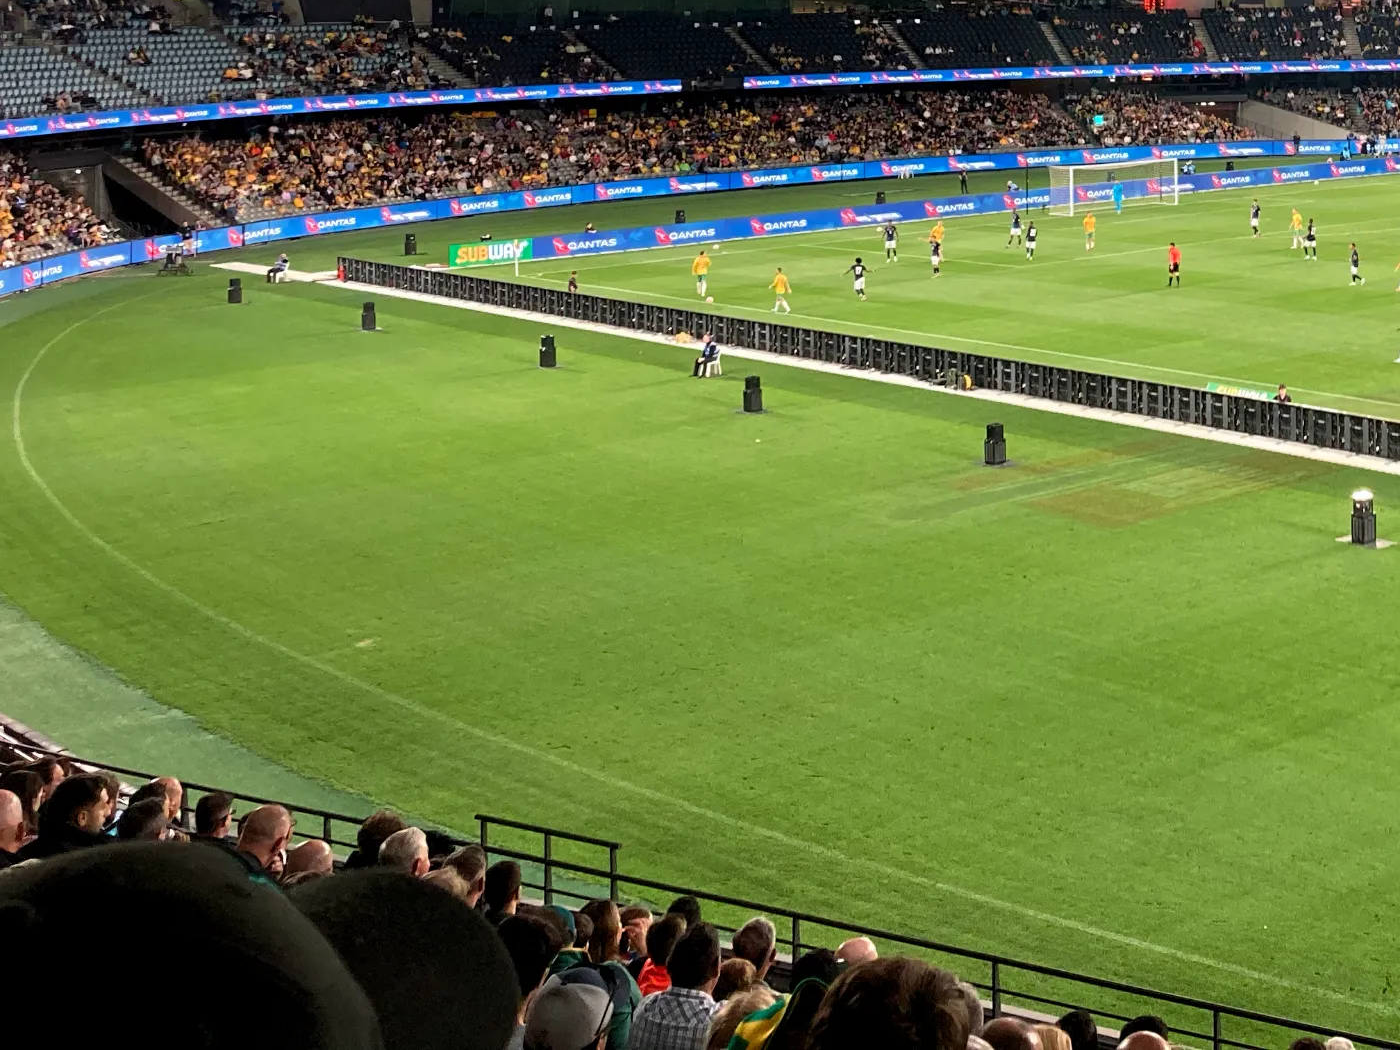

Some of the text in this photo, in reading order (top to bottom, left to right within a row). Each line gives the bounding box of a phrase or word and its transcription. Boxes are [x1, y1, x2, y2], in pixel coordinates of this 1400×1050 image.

[266, 104, 293, 112] QANTAS
[183, 110, 208, 118] QANTAS
[95, 117, 120, 125] QANTAS
[14, 125, 38, 133] QANTAS
[1161, 149, 1196, 158] QANTAS
[1299, 145, 1331, 153] QANTAS
[1027, 156, 1060, 164] QANTAS
[1093, 152, 1129, 161] QANTAS
[891, 164, 924, 172] QANTAS
[822, 169, 858, 179] QANTAS
[1282, 171, 1309, 179] QANTAS
[753, 175, 787, 183] QANTAS
[1221, 176, 1250, 185] QANTAS
[607, 186, 643, 197] QANTAS
[534, 193, 572, 204] QANTAS
[1014, 195, 1050, 205] QANTAS
[461, 200, 499, 211] QANTAS
[936, 203, 974, 213] QANTAS
[317, 217, 356, 229] QANTAS
[764, 219, 806, 230] QANTAS
[244, 227, 281, 241] QANTAS
[669, 228, 715, 240] QANTAS
[568, 238, 617, 250] QANTAS
[455, 240, 529, 264] SUBWAY
